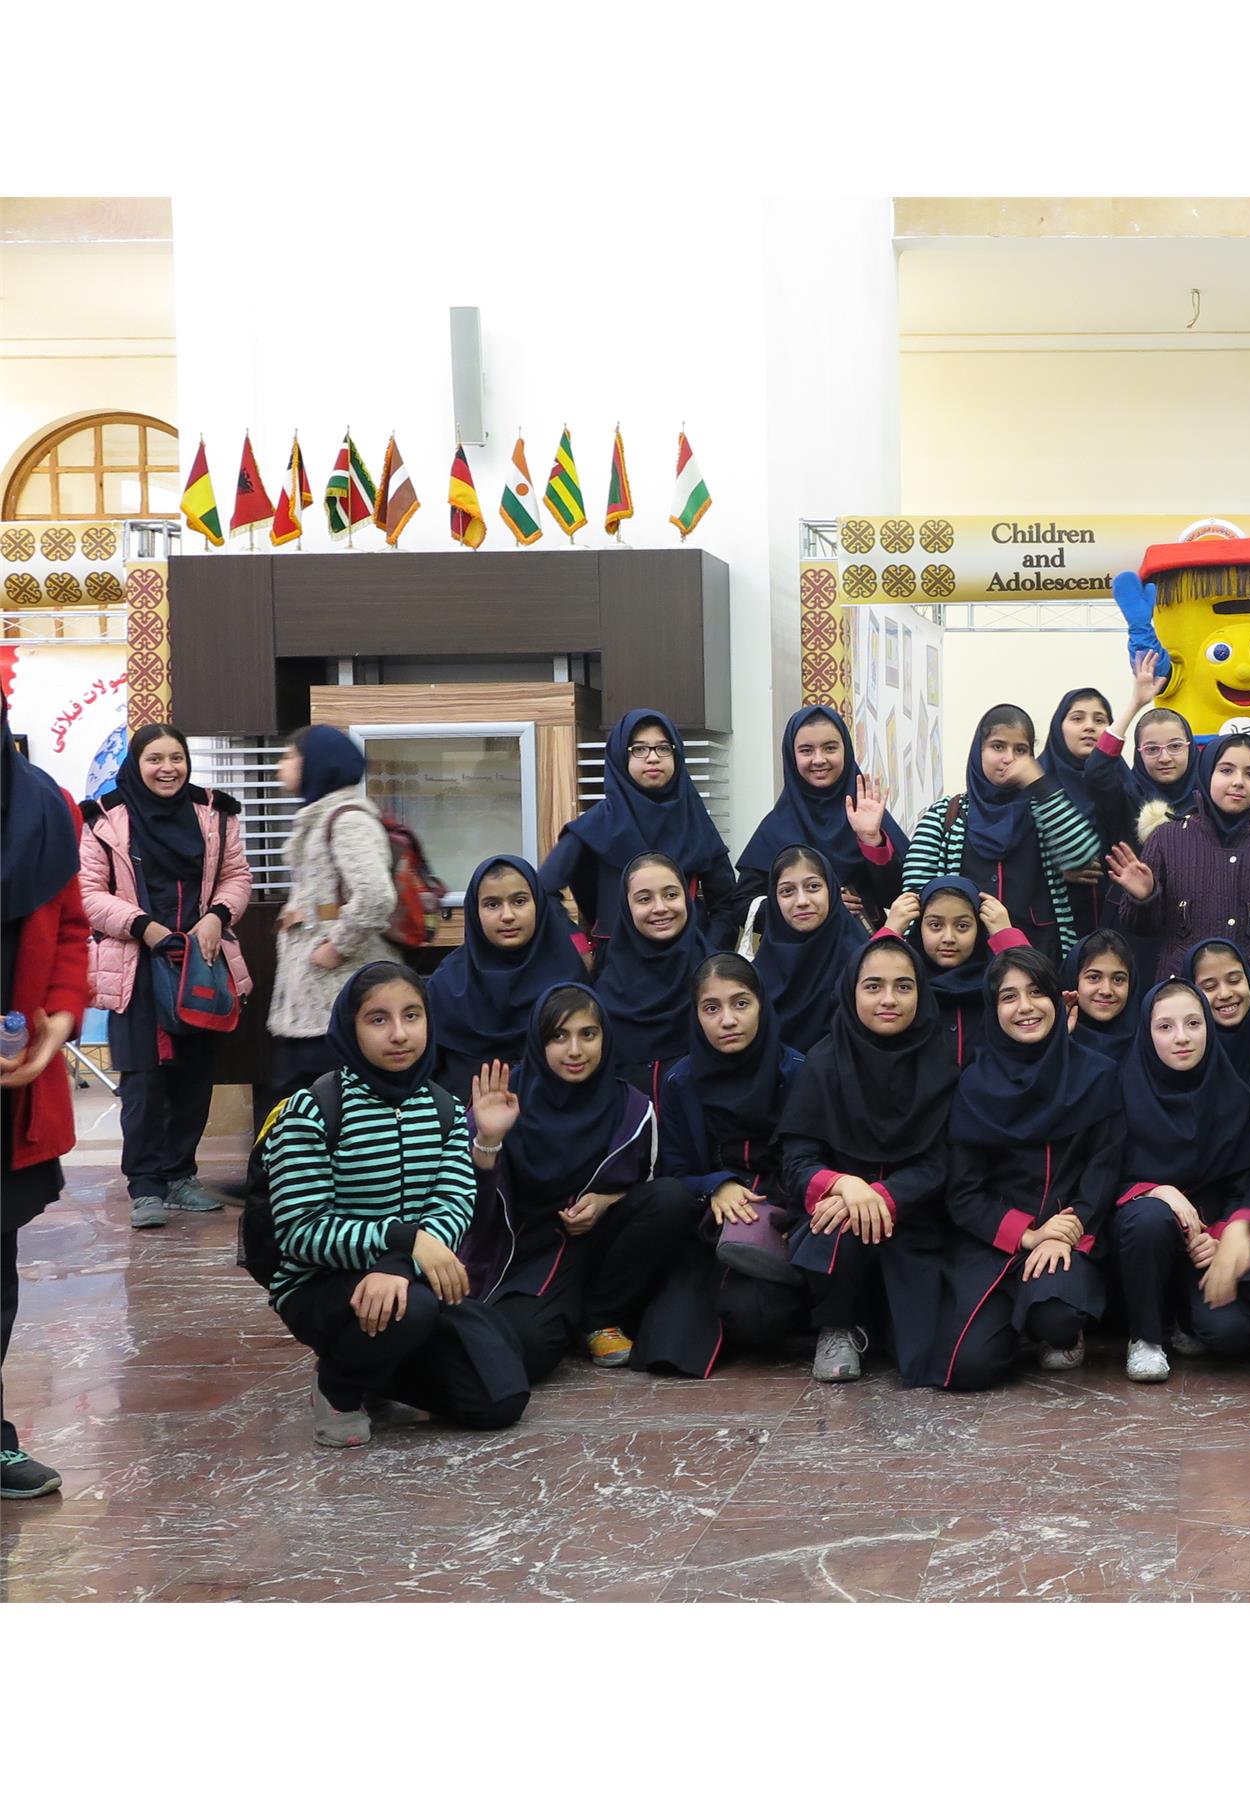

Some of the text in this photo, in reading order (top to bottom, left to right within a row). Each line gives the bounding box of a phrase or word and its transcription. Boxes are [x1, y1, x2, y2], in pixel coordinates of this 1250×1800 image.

[991, 522, 1096, 544] Children
[1022, 547, 1066, 568] and
[986, 571, 1113, 592] Adolescent
